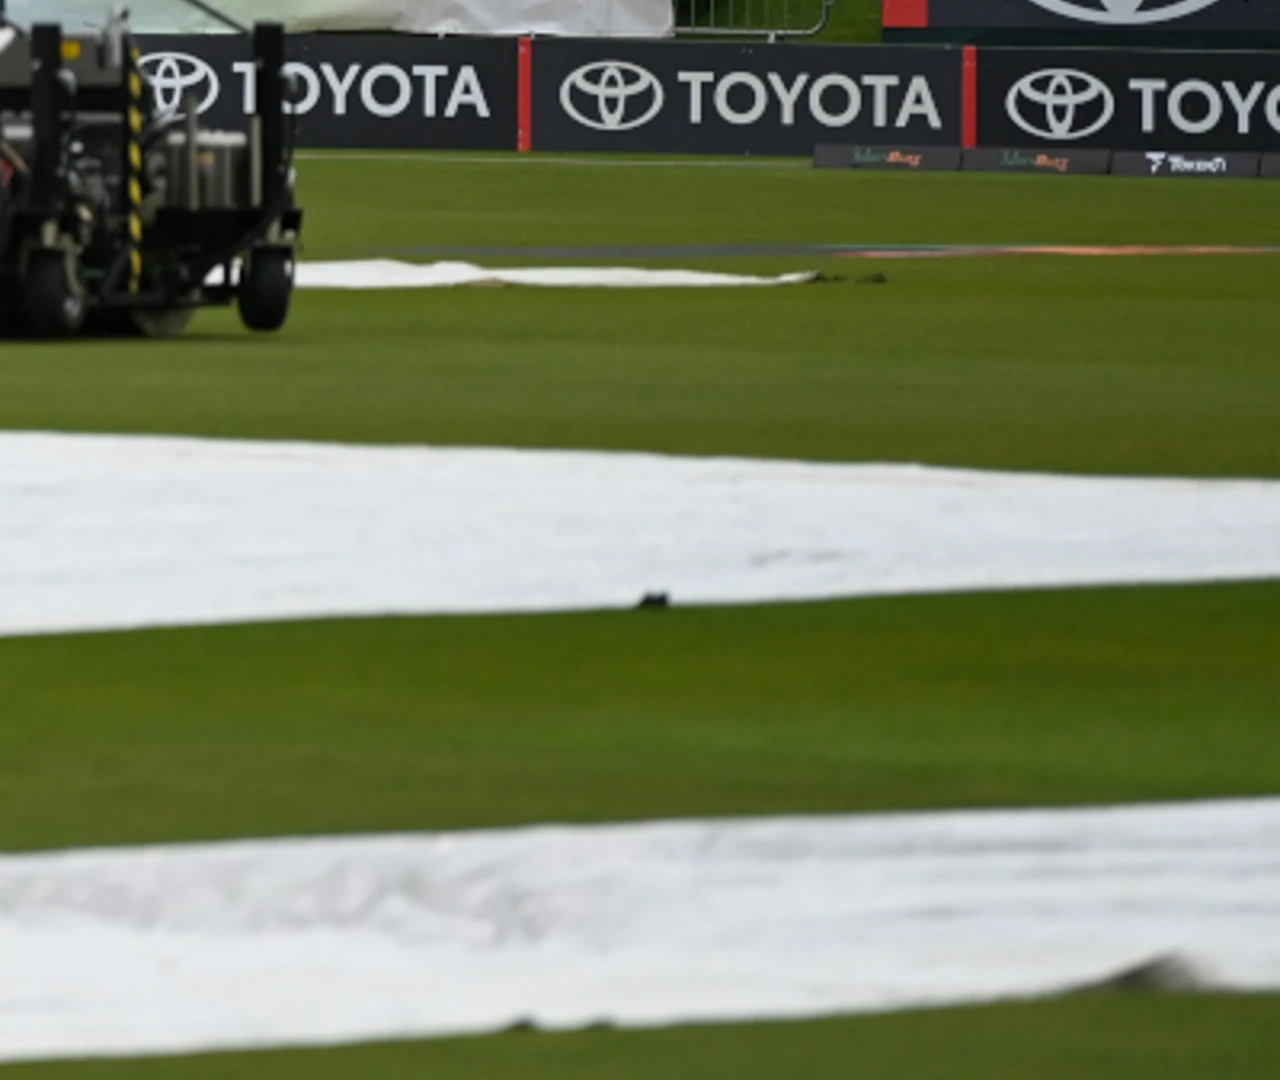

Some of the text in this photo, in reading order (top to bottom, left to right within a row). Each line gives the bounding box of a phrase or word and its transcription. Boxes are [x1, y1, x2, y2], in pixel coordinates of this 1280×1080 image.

[232, 62, 491, 118] TOYOTA
[677, 71, 942, 129] TOYOTA
[1128, 77, 1280, 135] TOY
